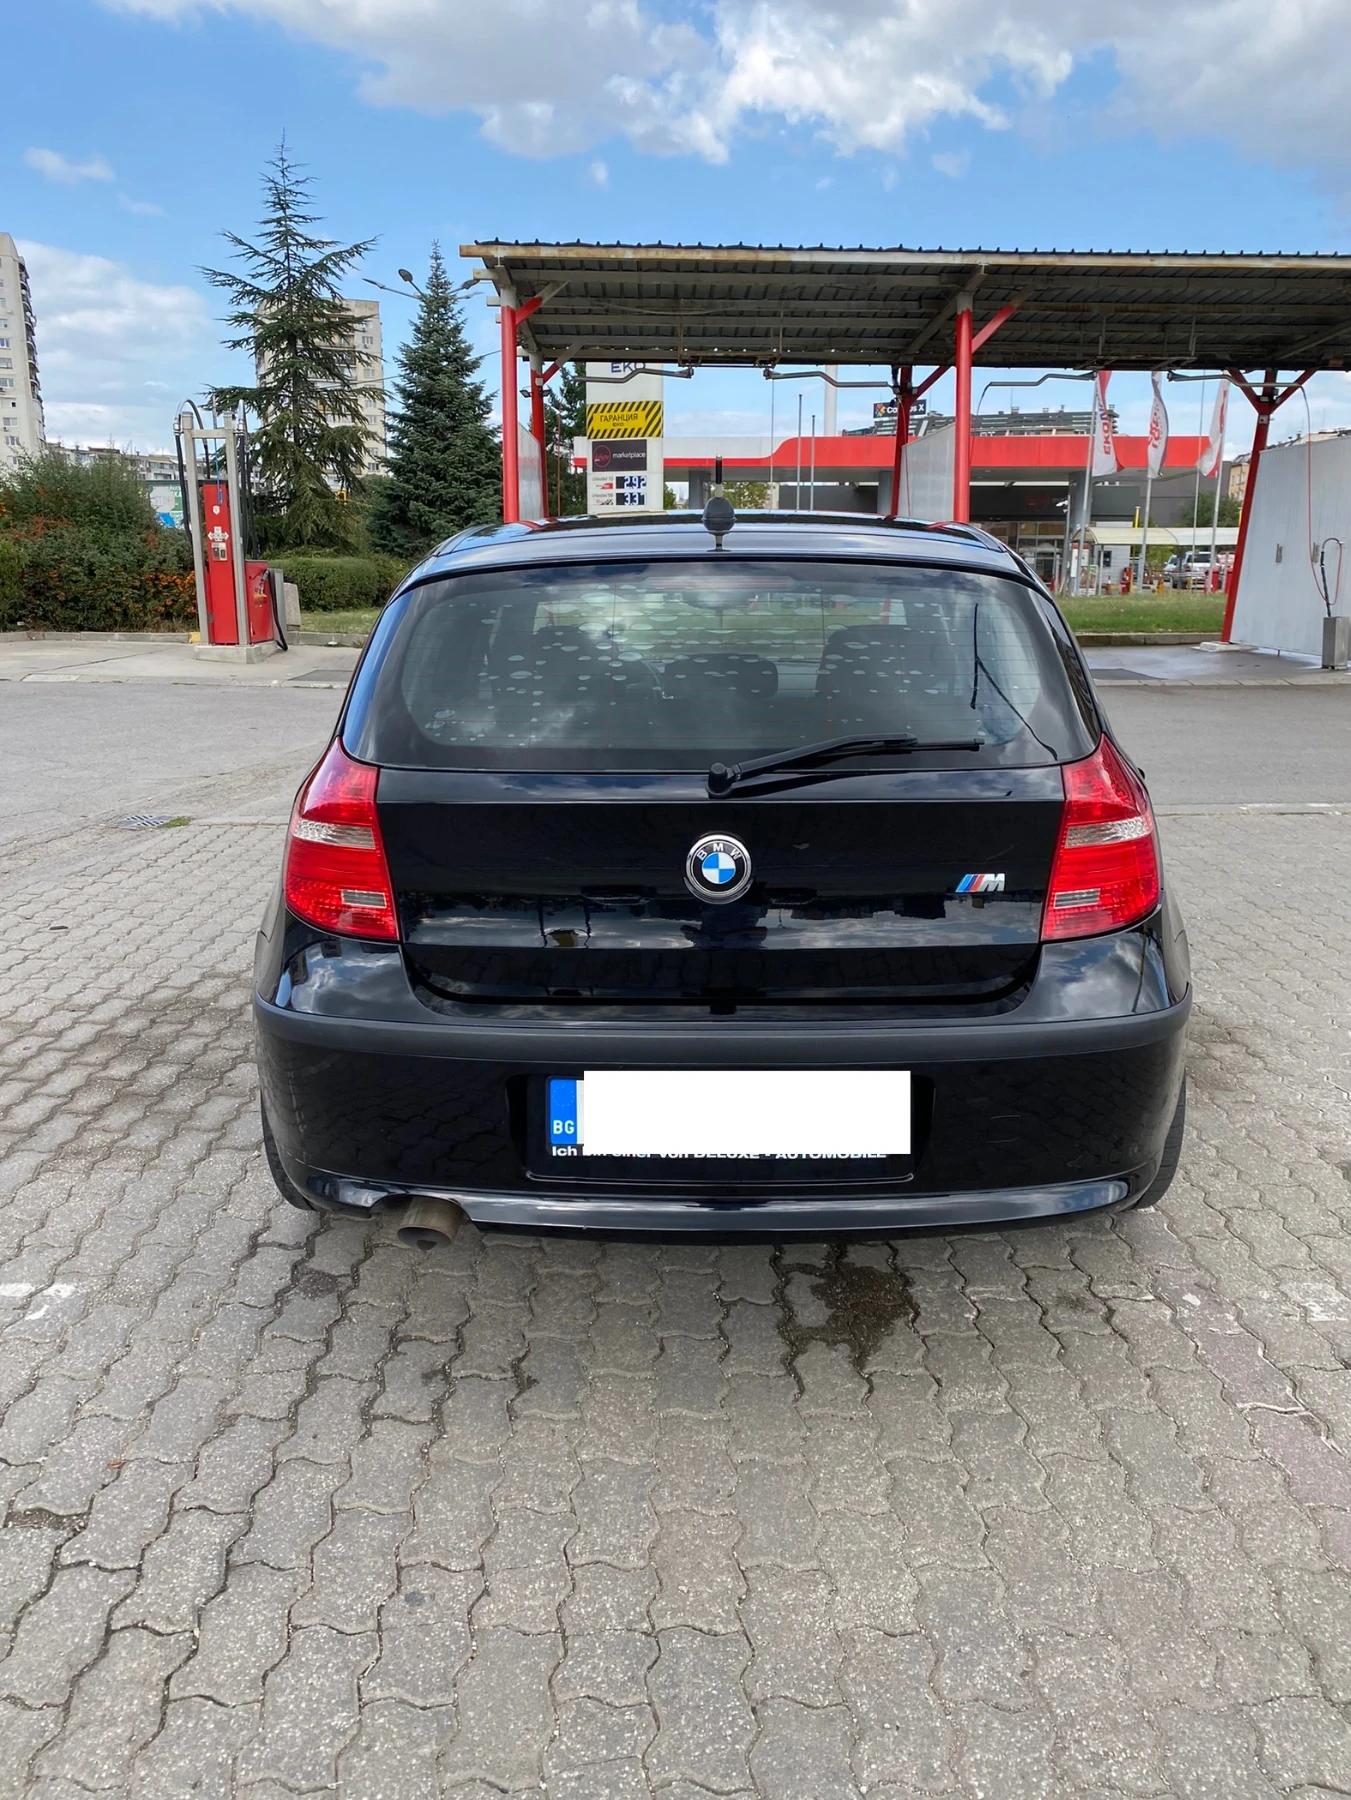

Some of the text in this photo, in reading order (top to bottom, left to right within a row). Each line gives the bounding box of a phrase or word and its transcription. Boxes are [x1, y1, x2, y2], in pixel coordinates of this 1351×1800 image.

[611, 362, 646, 373] EKO
[600, 413, 638, 422] ГАРАНЦИЯ
[696, 842, 742, 861] BMW
[976, 873, 1005, 892] M
[553, 1119, 575, 1135] BG
[552, 1145, 578, 1157] Ich
